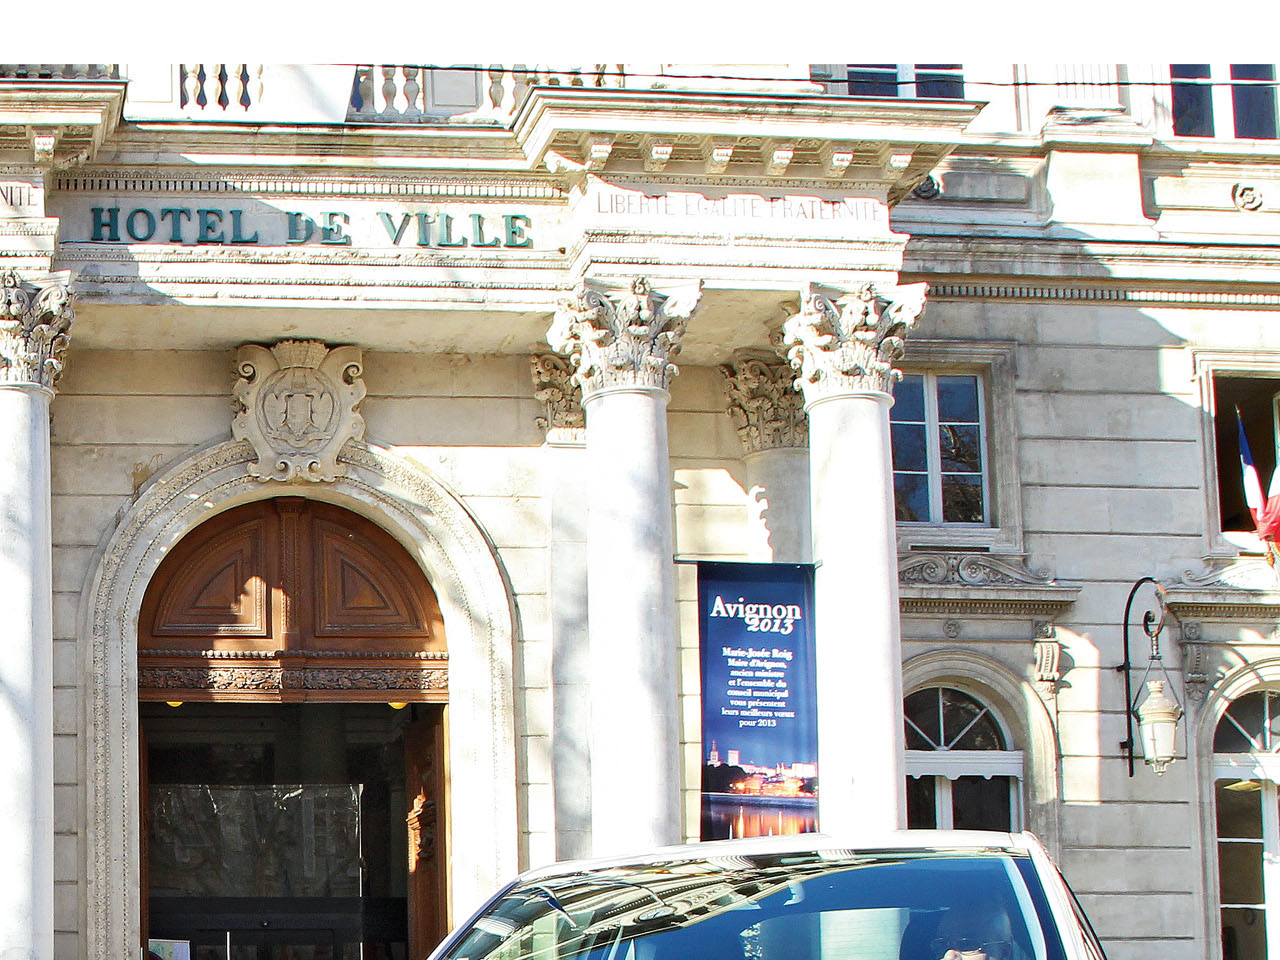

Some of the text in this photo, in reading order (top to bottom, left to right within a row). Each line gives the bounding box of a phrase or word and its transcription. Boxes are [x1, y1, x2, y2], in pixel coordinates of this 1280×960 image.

[90, 207, 535, 249] HOTEL DE VILLE
[710, 595, 802, 625] Avignon
[747, 617, 795, 635] 2013
[739, 719, 777, 728] pour 2013
